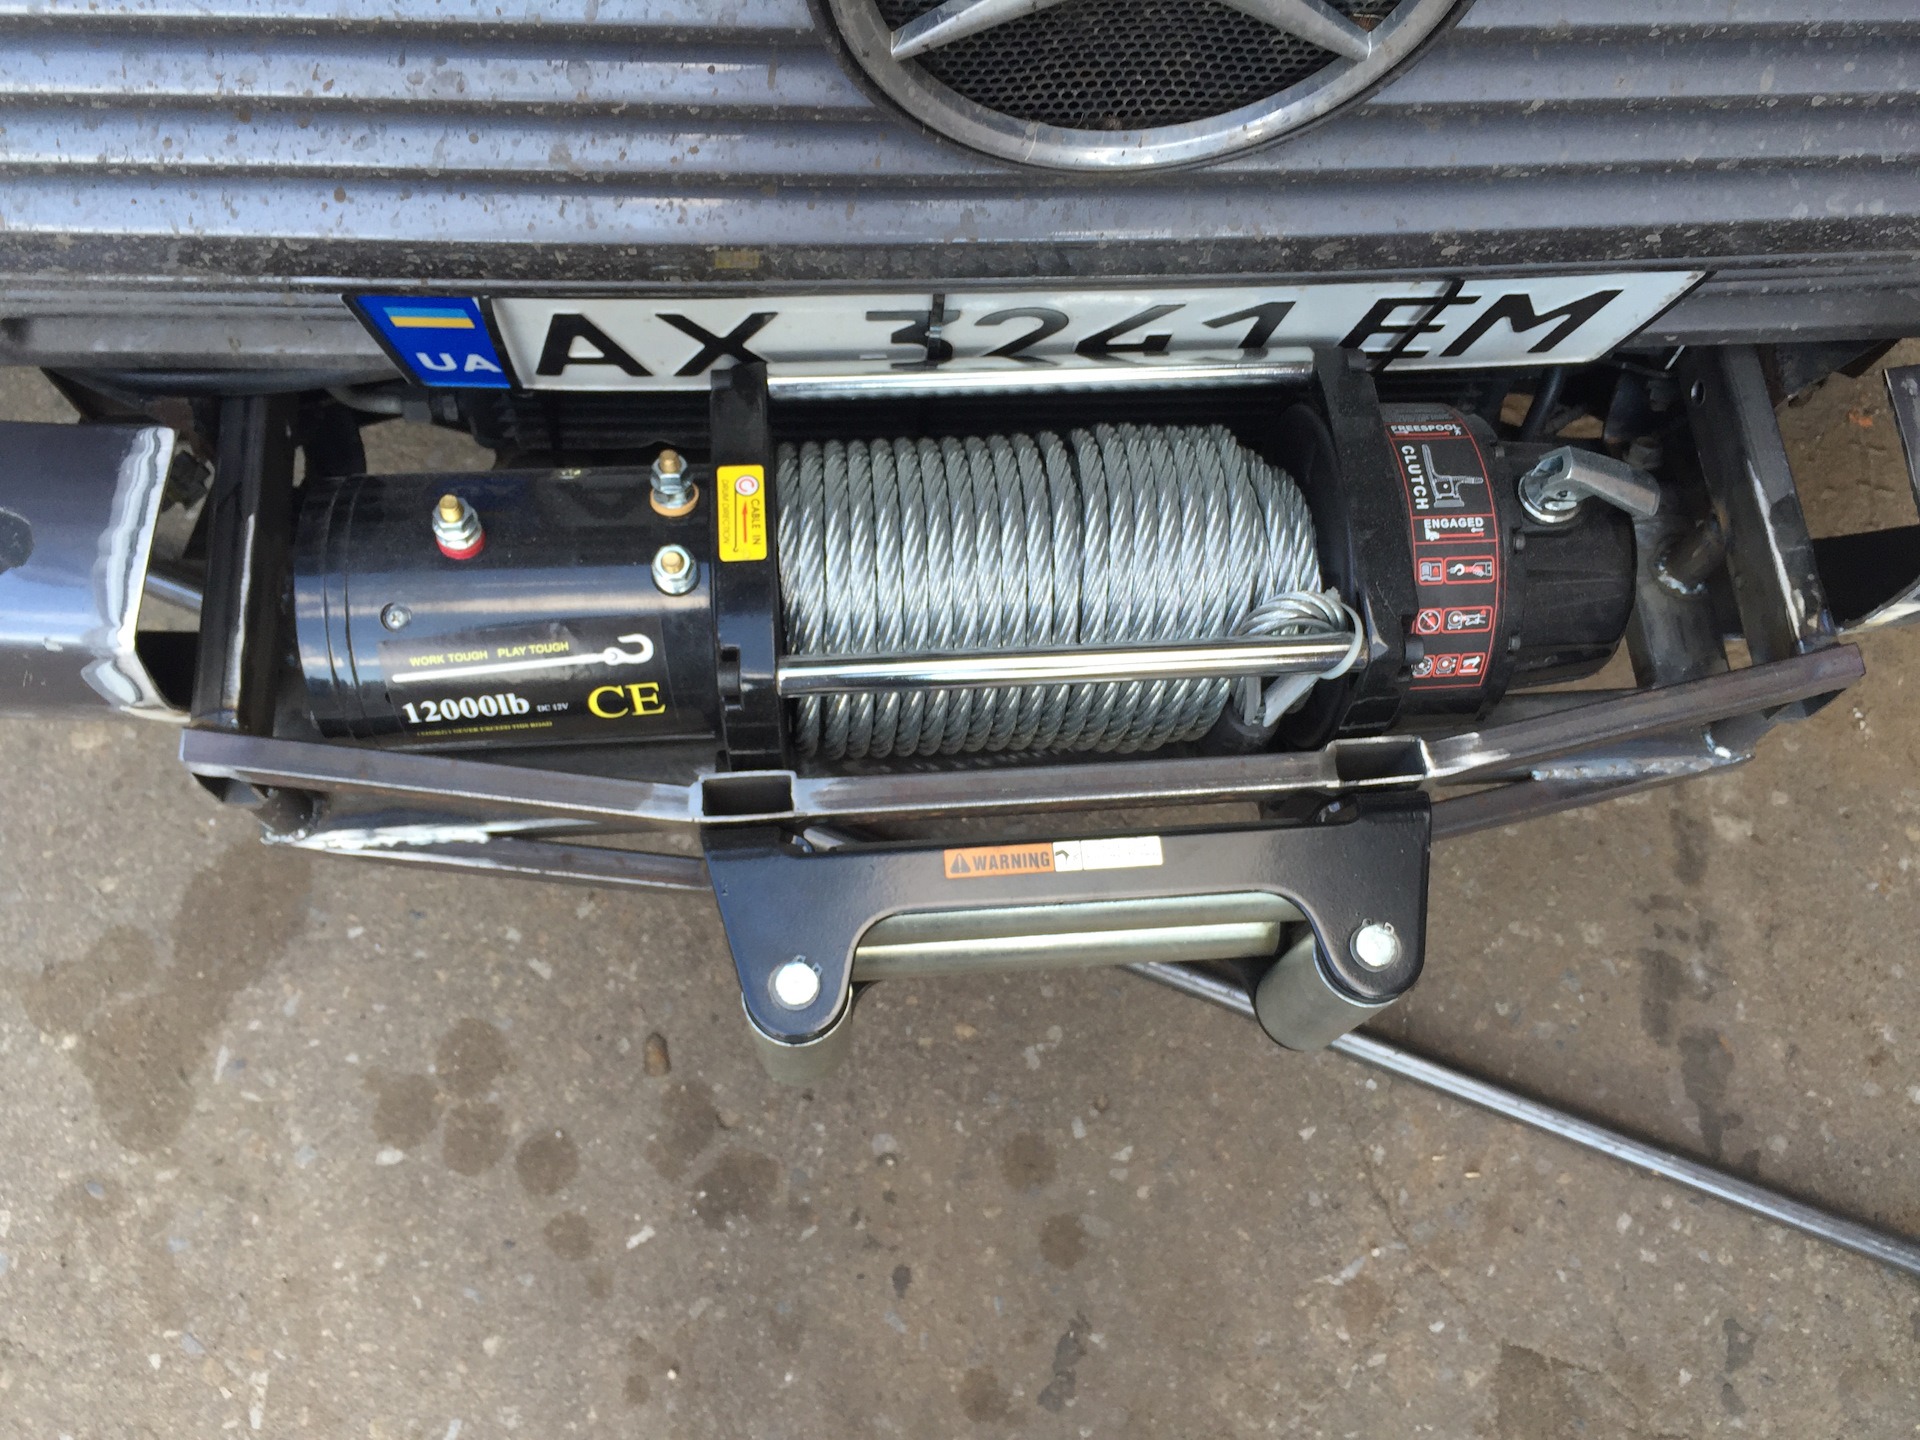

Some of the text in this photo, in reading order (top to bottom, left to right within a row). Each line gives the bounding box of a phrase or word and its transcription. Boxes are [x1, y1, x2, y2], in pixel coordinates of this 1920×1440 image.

[536, 289, 1624, 376] AX 3241 EM
[417, 352, 501, 372] UA
[1401, 445, 1429, 510] CLUTCH
[721, 479, 731, 544] DRUM DIRECTION
[751, 498, 761, 545] CABLE IN
[1423, 517, 1484, 529] ENGAGED
[409, 641, 569, 666] WORK TOUGH PLAY TOUGH
[402, 693, 569, 723] 12000lb DC 12V
[587, 682, 666, 718] CE
[973, 852, 1050, 871] WARNING
